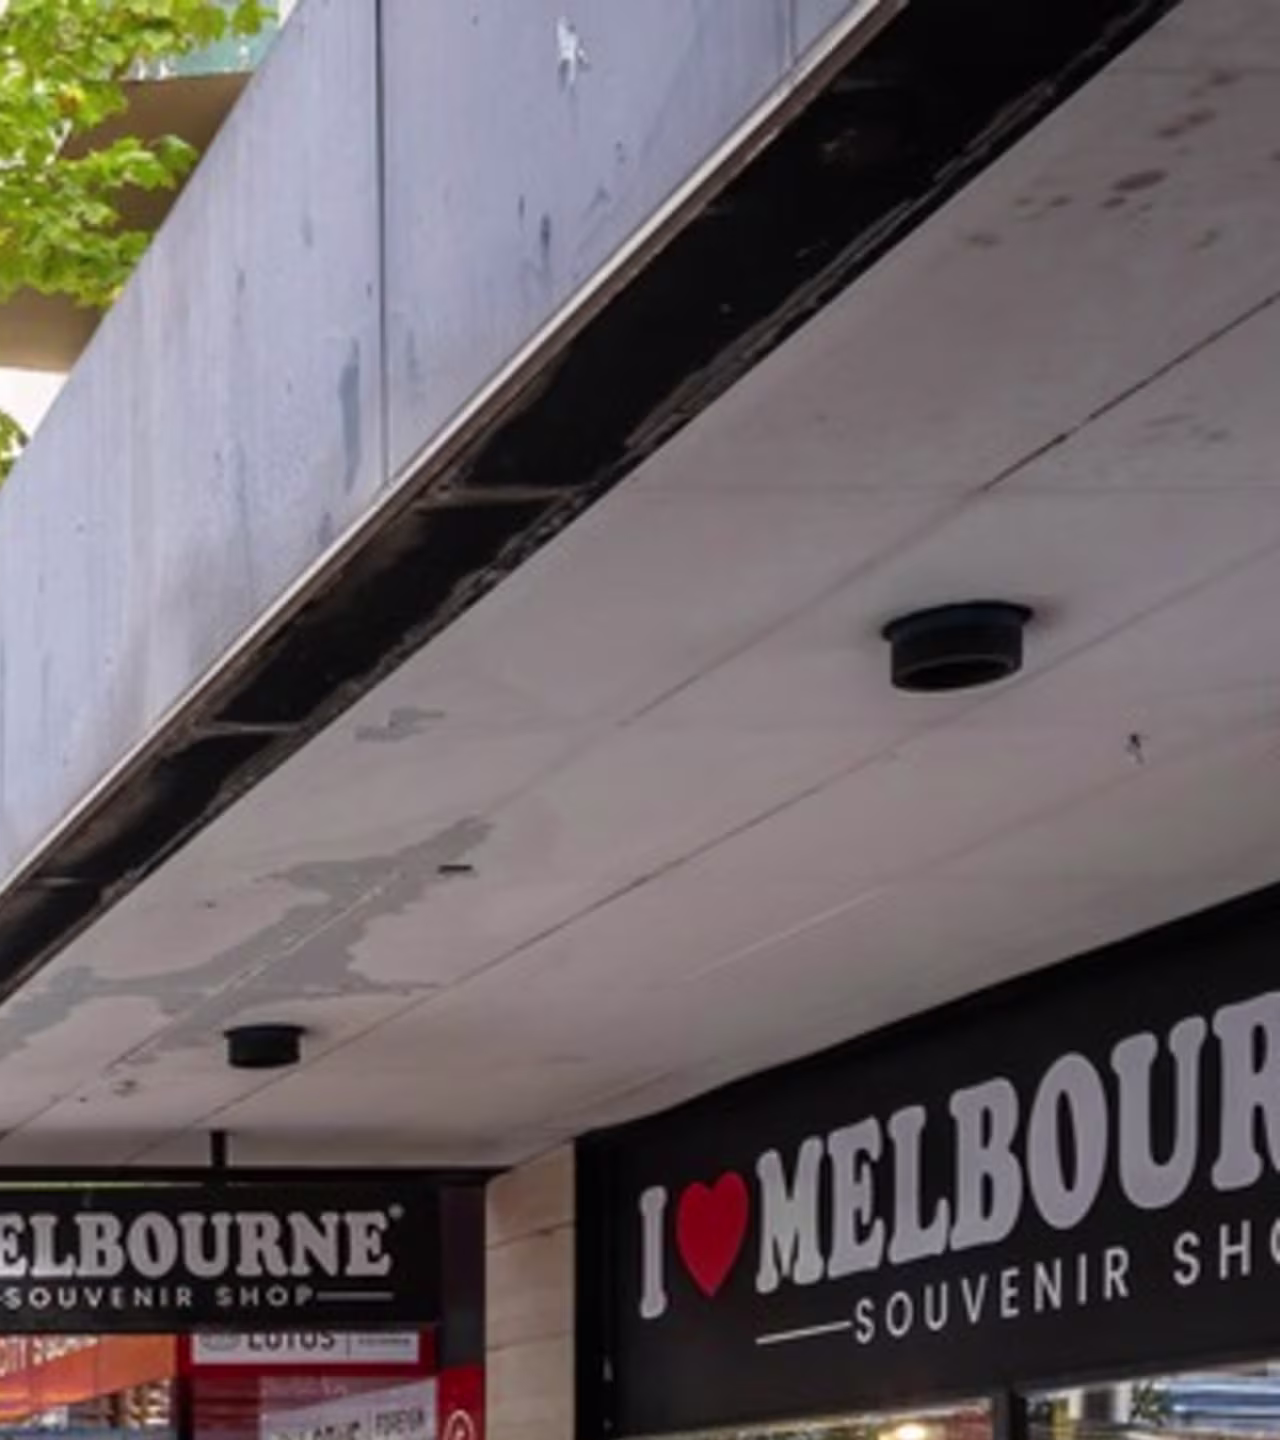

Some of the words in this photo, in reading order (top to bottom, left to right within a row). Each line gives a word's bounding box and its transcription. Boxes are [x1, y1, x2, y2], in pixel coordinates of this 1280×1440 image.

[639, 1186, 668, 1319] I
[756, 990, 1280, 1294] MELBOUR
[4, 1286, 194, 1309] SOUVENIR
[217, 1286, 315, 1309] SHOP
[854, 1247, 1130, 1345] SOUVENIR
